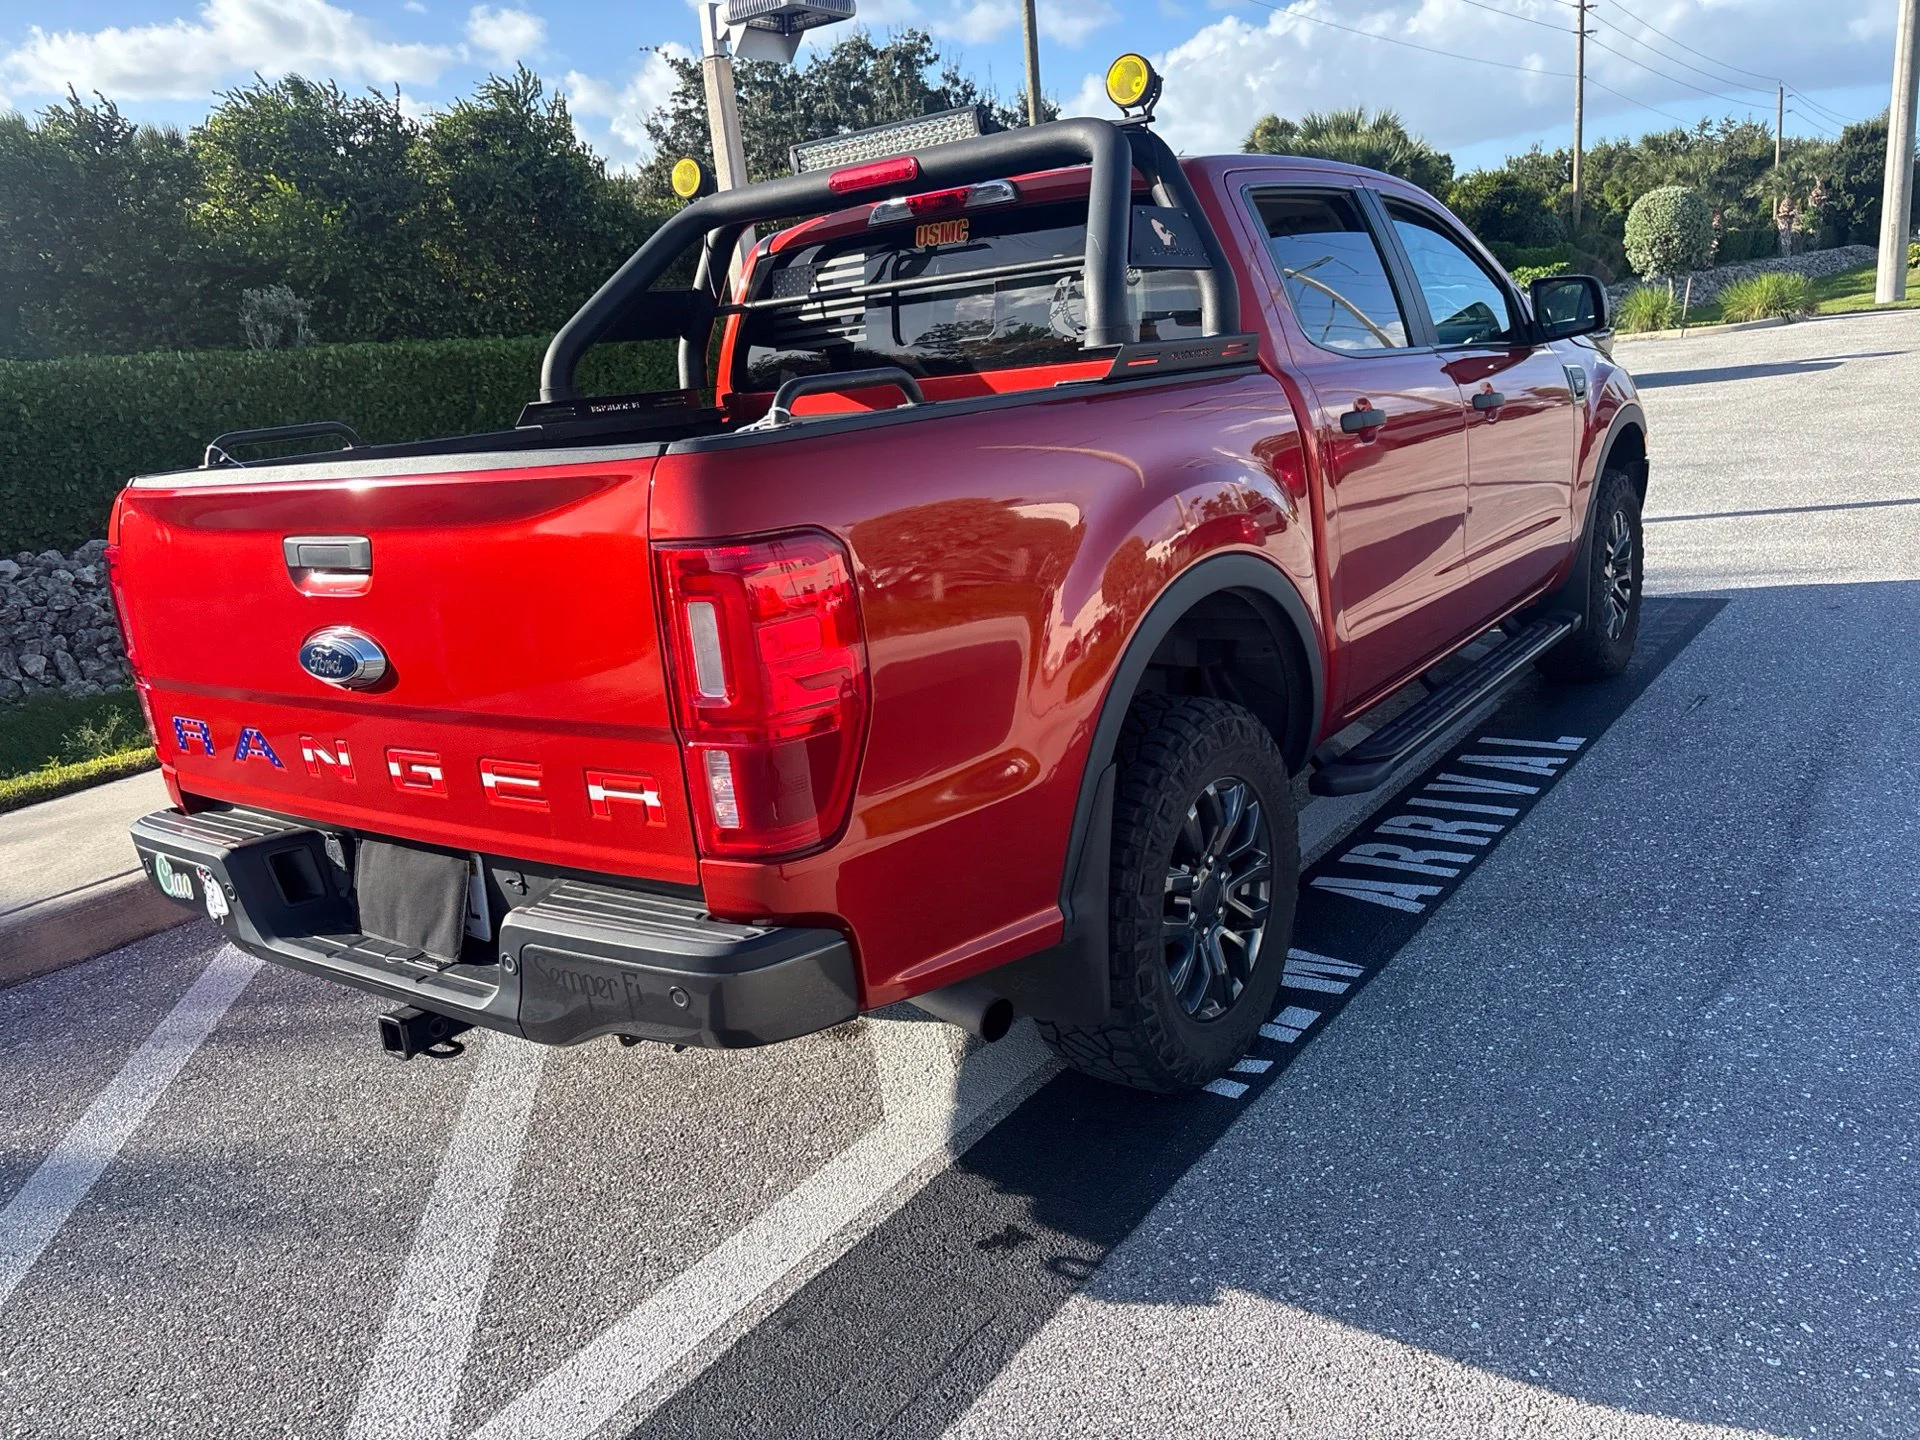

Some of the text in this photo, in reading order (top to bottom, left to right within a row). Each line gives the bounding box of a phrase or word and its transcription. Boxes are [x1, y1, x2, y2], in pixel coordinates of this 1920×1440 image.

[917, 219, 969, 248] USMC
[309, 647, 343, 675] Ford
[173, 715, 666, 827] RANGER
[1309, 735, 1588, 914] ARRIVAL
[156, 851, 194, 901] Ciao
[532, 954, 644, 1019] Semper Fi
